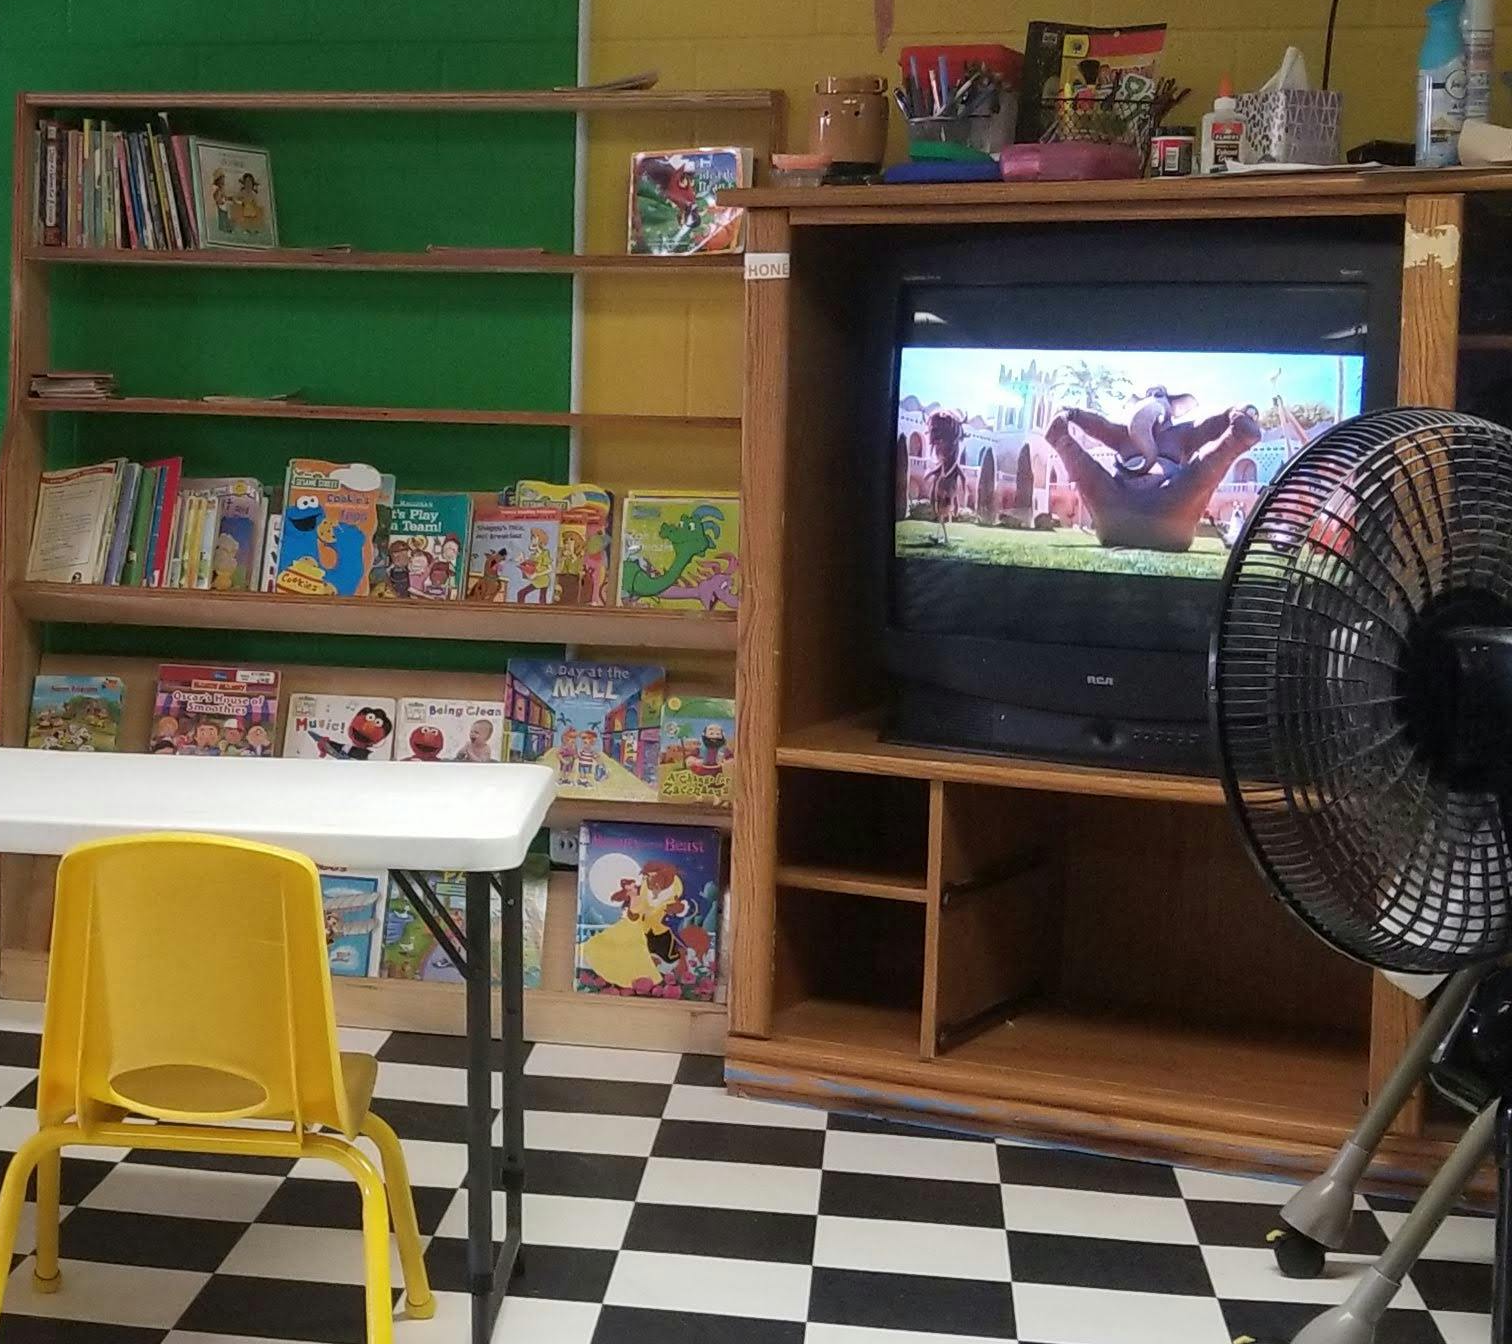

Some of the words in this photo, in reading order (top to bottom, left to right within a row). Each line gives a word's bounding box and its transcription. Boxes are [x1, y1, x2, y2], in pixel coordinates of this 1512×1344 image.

[409, 509, 440, 523] Play
[402, 520, 442, 533] Team!
[545, 665, 553, 675] A
[557, 665, 583, 679] Day
[587, 667, 603, 678] at
[607, 666, 630, 679] the
[1087, 675, 1114, 686] RCA
[552, 676, 618, 700] MALL
[173, 690, 212, 703] Oscar's
[214, 693, 249, 705] House
[251, 695, 265, 706] of
[187, 702, 248, 716] Smoothies
[429, 704, 464, 717] Being
[466, 705, 502, 717] Clean
[664, 836, 705, 853] Beast
